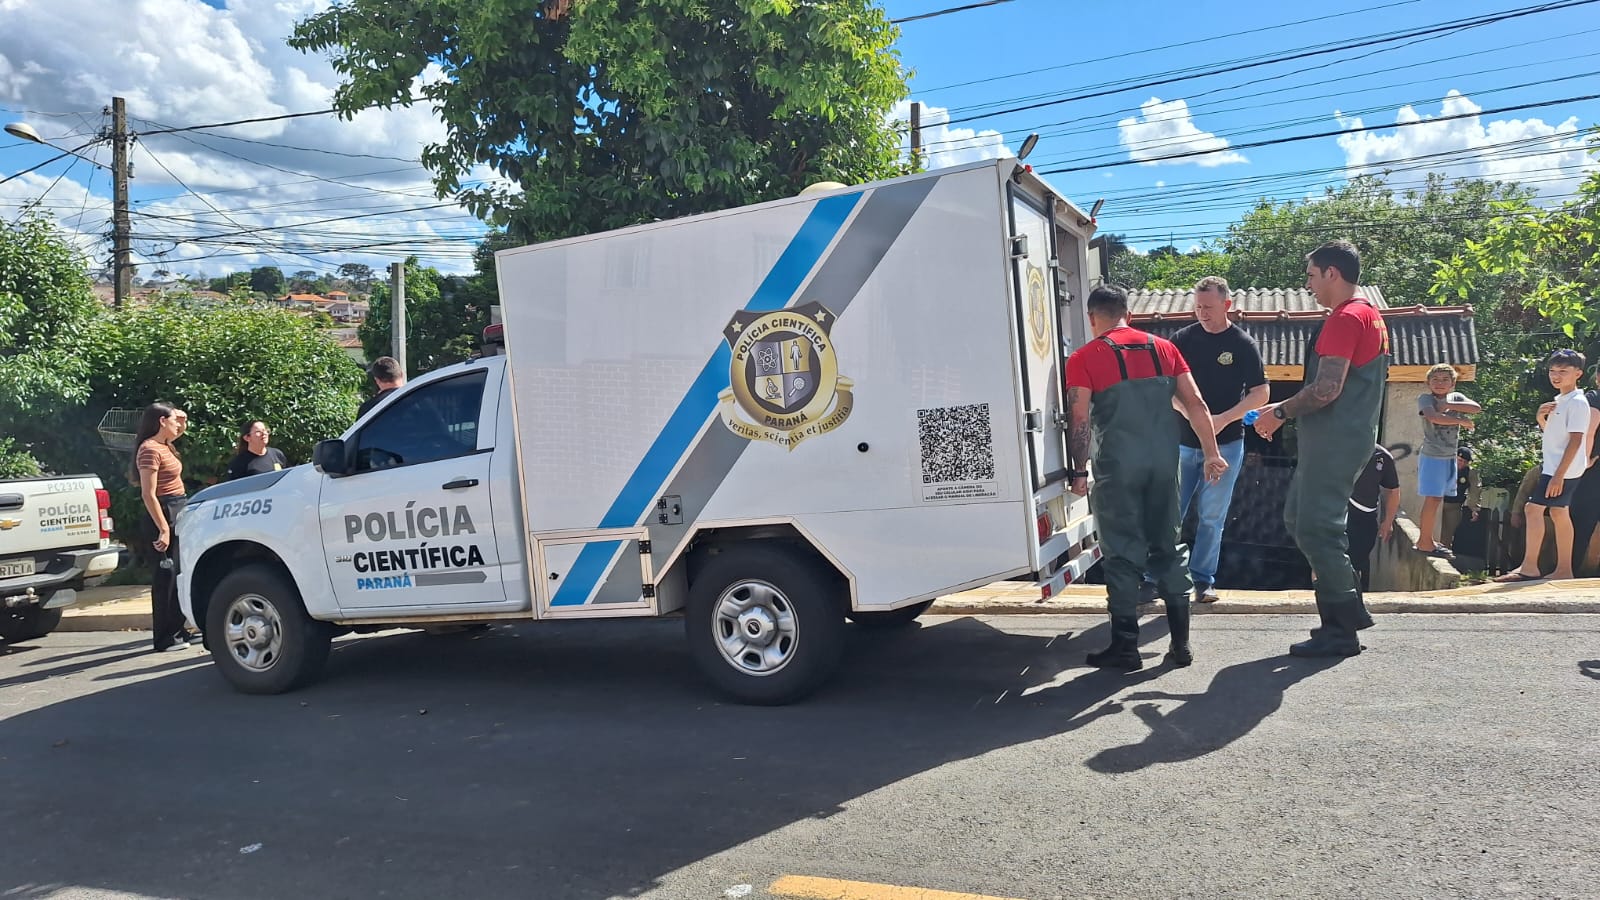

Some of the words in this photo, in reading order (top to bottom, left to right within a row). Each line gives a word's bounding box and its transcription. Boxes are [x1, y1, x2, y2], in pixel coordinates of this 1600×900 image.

[736, 322, 770, 361] POLÍCIA
[771, 318, 827, 353] CIENTÍFICA
[728, 419, 762, 439] veritas,
[764, 430, 805, 446] scientia
[806, 427, 817, 436] et
[818, 406, 850, 435] justitia
[764, 411, 809, 428] PARANÁ
[47, 481, 85, 492] PC2320
[38, 503, 91, 517] POLÍCIA
[212, 499, 273, 520] LR2505
[40, 515, 92, 527] CIENTÍFICA
[344, 500, 477, 543] POLÍCIA
[353, 542, 485, 573] CIENTÍFICA
[357, 572, 412, 590] PARANÁ
